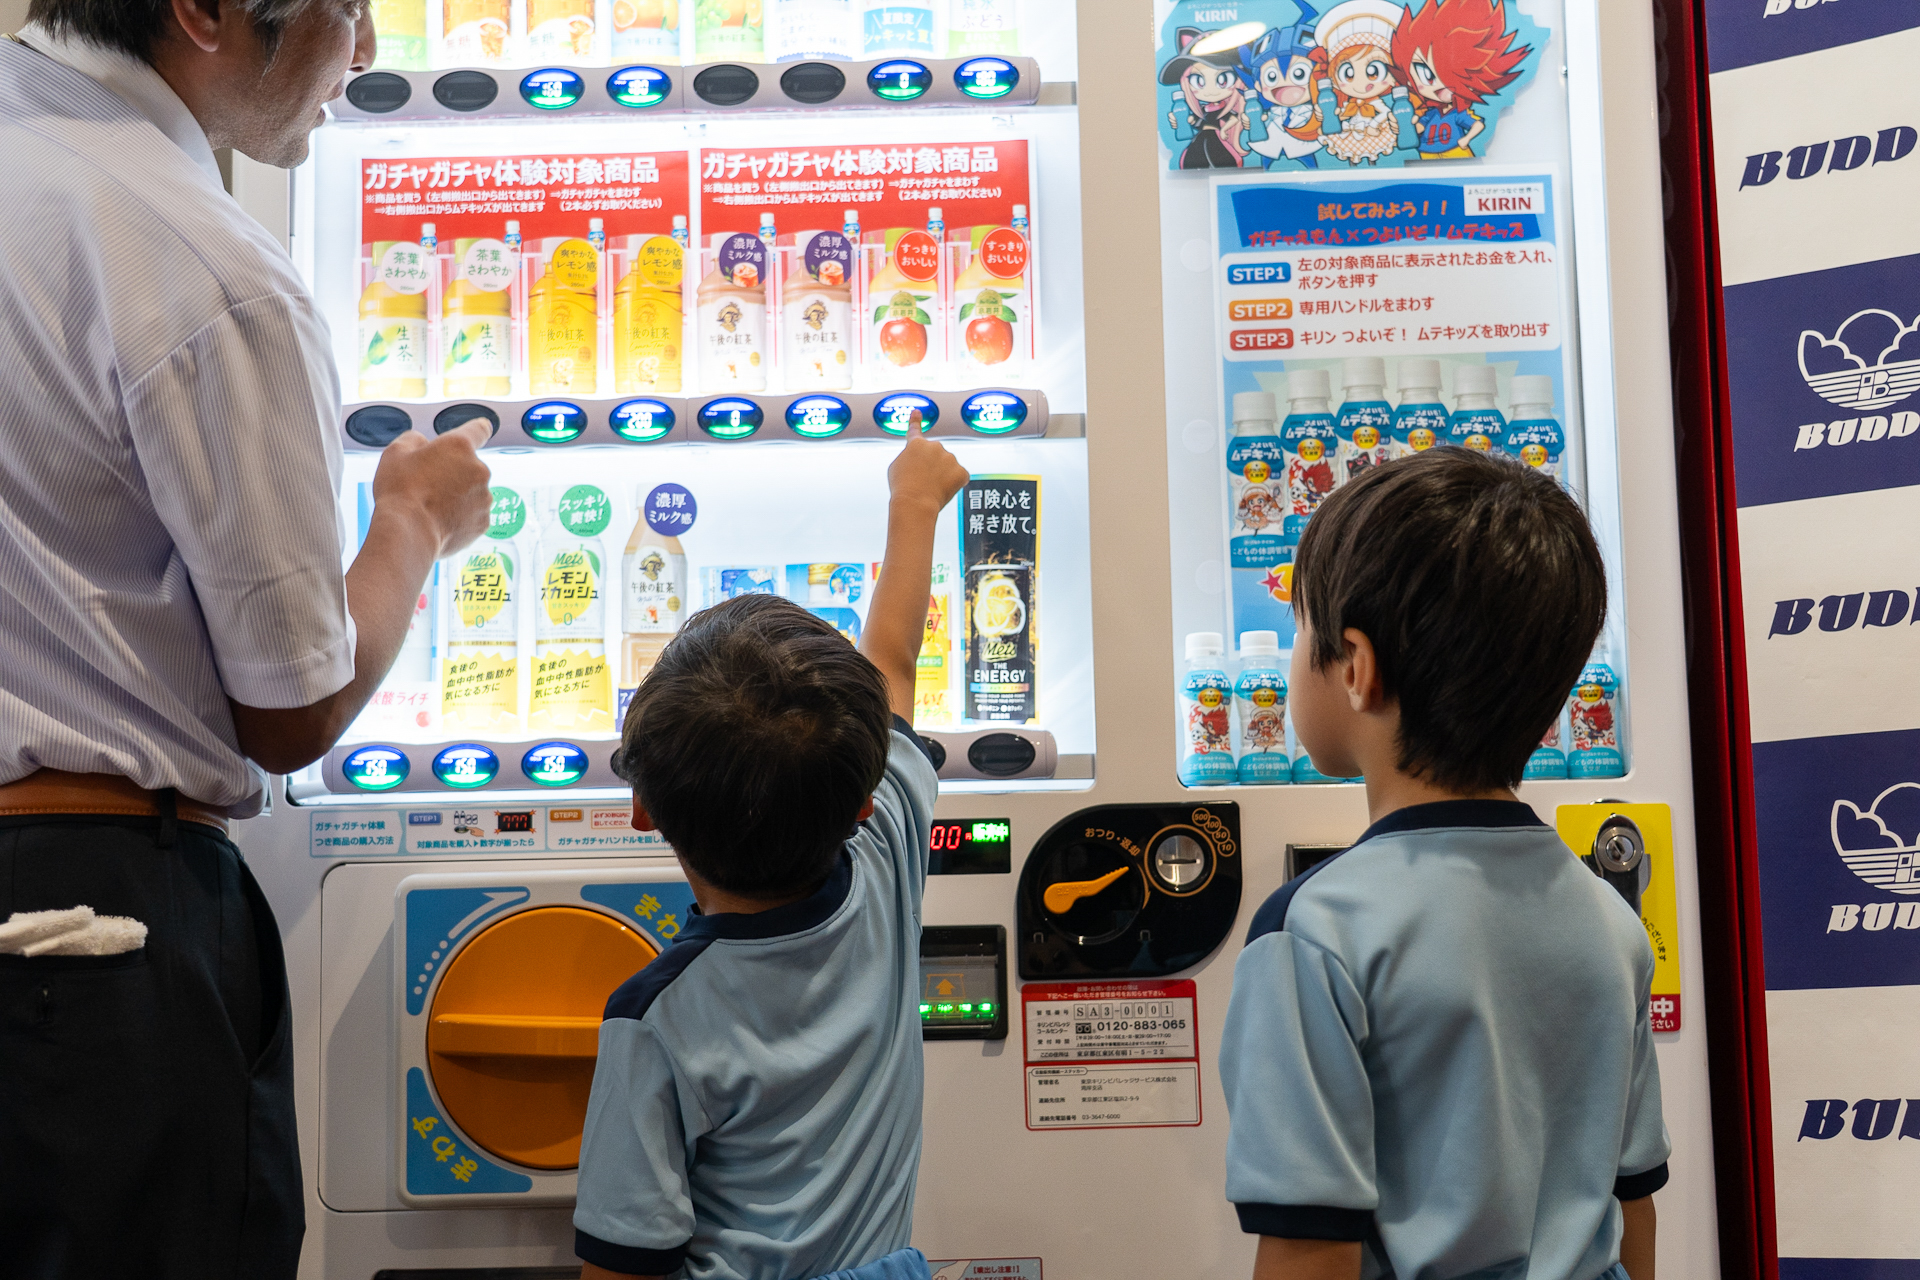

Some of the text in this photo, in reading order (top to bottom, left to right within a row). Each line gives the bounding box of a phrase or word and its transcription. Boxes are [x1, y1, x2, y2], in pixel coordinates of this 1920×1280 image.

[963, 15, 1003, 29] ぶどう
[1194, 9, 1238, 23] KIRIN
[1427, 121, 1451, 147] 10
[702, 146, 998, 179] ガチャガチャ体験対象商品
[365, 157, 659, 190] ガチャガチャ体験対象商品
[1317, 200, 1448, 222] 試してみよう！！
[1478, 196, 1531, 212] KIRIN
[732, 236, 758, 250] 濃厚
[818, 235, 844, 248] 濃厚
[986, 241, 1025, 254] すっきり
[475, 249, 502, 262] 茶葉
[559, 247, 595, 260] 爽やかな
[646, 245, 681, 257] 爽やかな
[728, 249, 763, 263] ミルク感
[813, 248, 849, 262] ミルク感
[900, 243, 938, 256] すっきり
[393, 251, 420, 264] 茶葉
[642, 258, 684, 271] レモン感
[900, 255, 937, 269] おいしい
[986, 253, 1024, 266] おいしい
[385, 265, 430, 279] さわやか
[468, 262, 512, 277] さわやか
[556, 259, 598, 273] レモン感
[1232, 250, 1553, 282] STEP1 左の対象商品に表示されたお金を入れ、
[1298, 272, 1380, 290] ボタンを押す
[1233, 296, 1436, 318] STEP2 専用ハンドルをまわす
[539, 327, 584, 341] 午後の紅茶
[625, 327, 670, 340] 午後の紅茶
[709, 332, 753, 346] 午後の紅茶
[795, 332, 840, 345] 午後の紅茶
[1234, 333, 1290, 349] STEP3
[1300, 331, 1337, 346] キリン
[397, 325, 413, 361] 生茶
[480, 325, 497, 360] 生茶
[804, 408, 828, 425] 200
[980, 404, 1004, 421] 200
[628, 412, 652, 430] 200
[1340, 413, 1391, 427] ムテキッズ
[1395, 416, 1447, 429] ムテキッズ
[1285, 426, 1336, 439] ムテキッズ
[1451, 422, 1502, 435] ムテキッズ
[1507, 432, 1559, 445] ムテキッズ
[1231, 448, 1282, 462] ムテキッズ
[560, 493, 608, 512] スッキリ
[655, 492, 687, 509] 濃厚
[968, 489, 1032, 509] 冒険心を
[648, 509, 693, 526] ミルク感
[968, 514, 1037, 535] 解き放て。
[466, 554, 498, 571] Mets
[553, 551, 585, 570] Mets
[461, 574, 502, 587] レモン
[548, 571, 589, 585] レモン
[540, 586, 600, 601] スカッシュ
[631, 581, 674, 595] 午後の紅茶
[454, 589, 513, 602] スカッシュ
[1768, 586, 1920, 640] BUD
[449, 661, 478, 675] 食後の
[538, 658, 568, 674] 食後の
[446, 665, 516, 689] 血中中性脂肪が
[535, 663, 605, 687] 血中中性脂肪が
[974, 669, 1026, 683] ENERGY
[533, 679, 591, 700] 気になる方に
[1186, 678, 1231, 690] ムテキッズ
[1240, 678, 1285, 690] ムテキッズ
[444, 682, 501, 702] 気になる方に
[365, 759, 388, 776] 150
[455, 757, 476, 775] 150
[544, 755, 566, 773] 150
[413, 815, 438, 823] STEP1
[503, 815, 528, 829] 777
[1194, 813, 1209, 821] 500
[315, 821, 386, 831] ガチャガチャ体験
[1207, 821, 1220, 829] 100
[315, 836, 394, 847] つき商品の購入方法
[1085, 827, 1141, 857] おつり・返却
[1216, 831, 1228, 839] 50
[1221, 843, 1233, 852] 10
[1097, 1019, 1187, 1032] 0120-883-065
